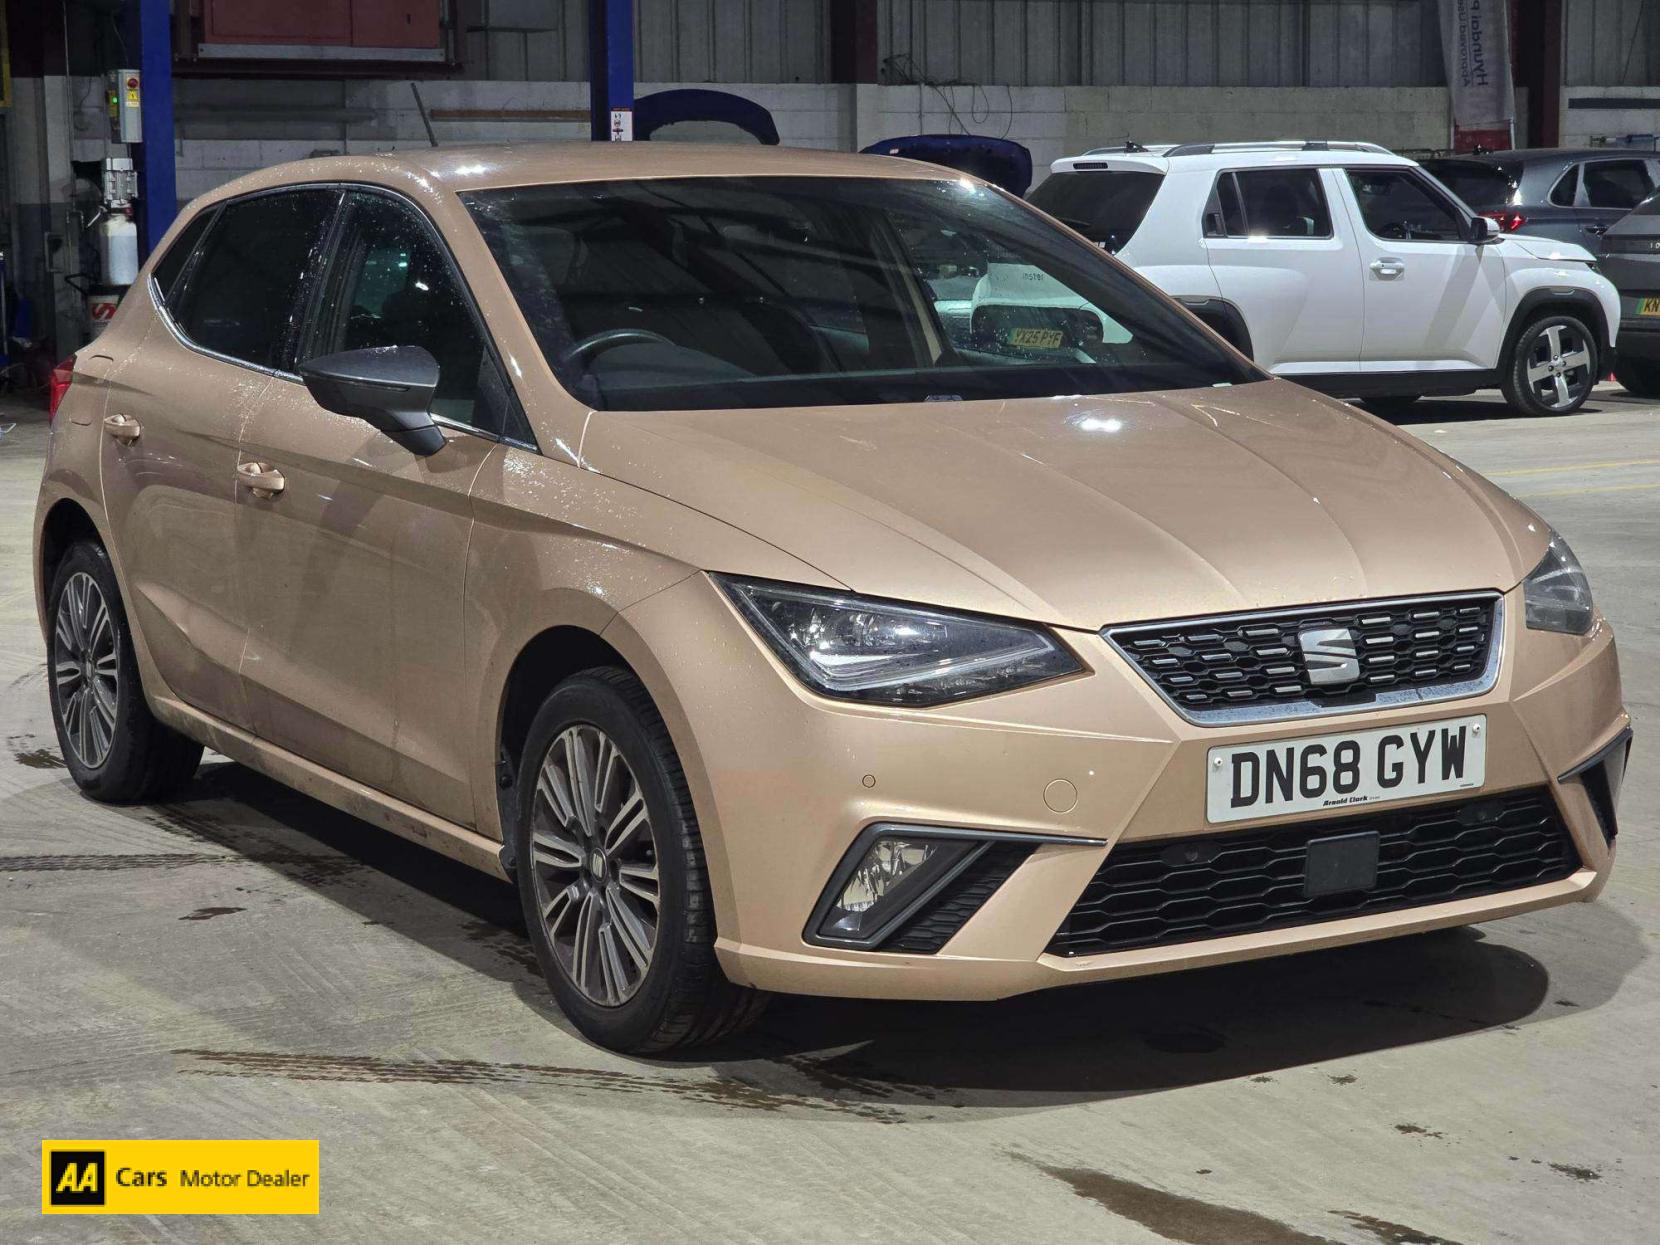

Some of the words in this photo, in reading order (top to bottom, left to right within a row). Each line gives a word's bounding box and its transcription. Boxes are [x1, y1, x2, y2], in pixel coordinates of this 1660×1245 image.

[1231, 740, 1361, 808] DN68
[1377, 726, 1467, 788] GYW
[1322, 797, 1348, 807] Arnold
[1349, 795, 1368, 803] Clark
